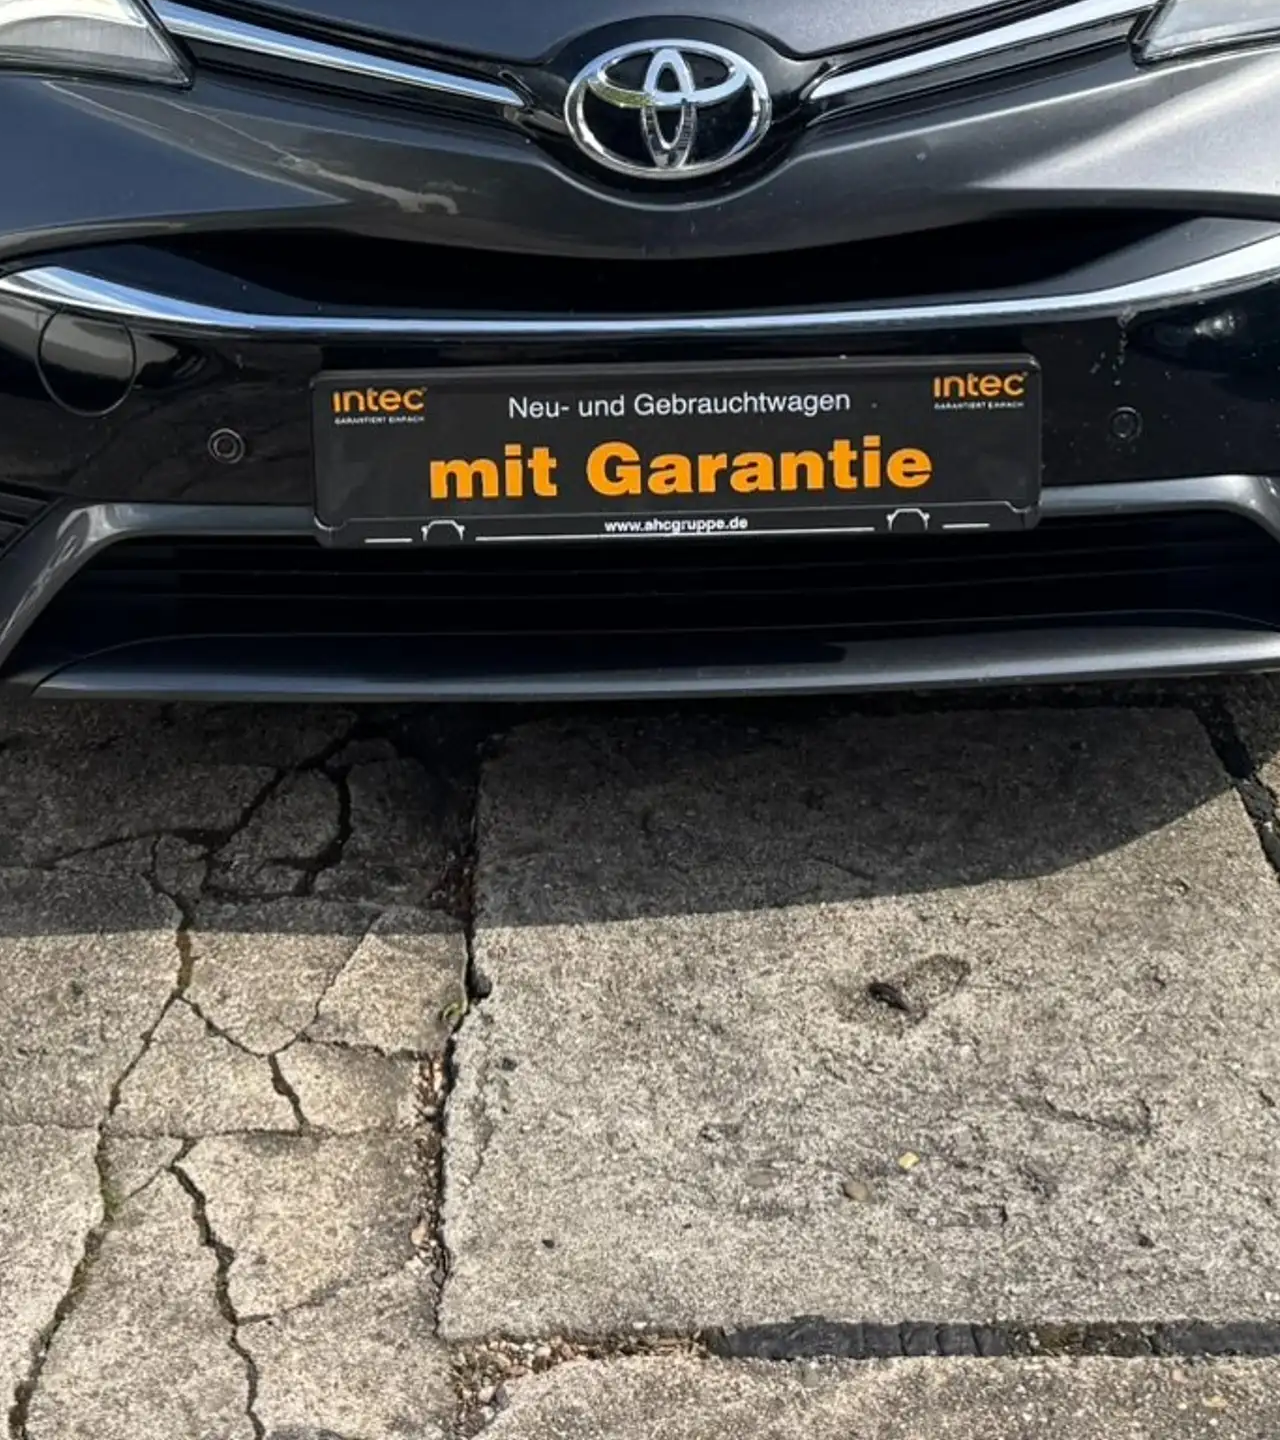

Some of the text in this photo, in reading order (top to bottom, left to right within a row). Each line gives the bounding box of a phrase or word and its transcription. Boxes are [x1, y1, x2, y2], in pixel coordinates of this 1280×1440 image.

[508, 391, 851, 419] Neu- und Gebrauchtwagen
[429, 435, 932, 499] mit Garantie
[604, 516, 749, 534] www.ahcgruppe.de
